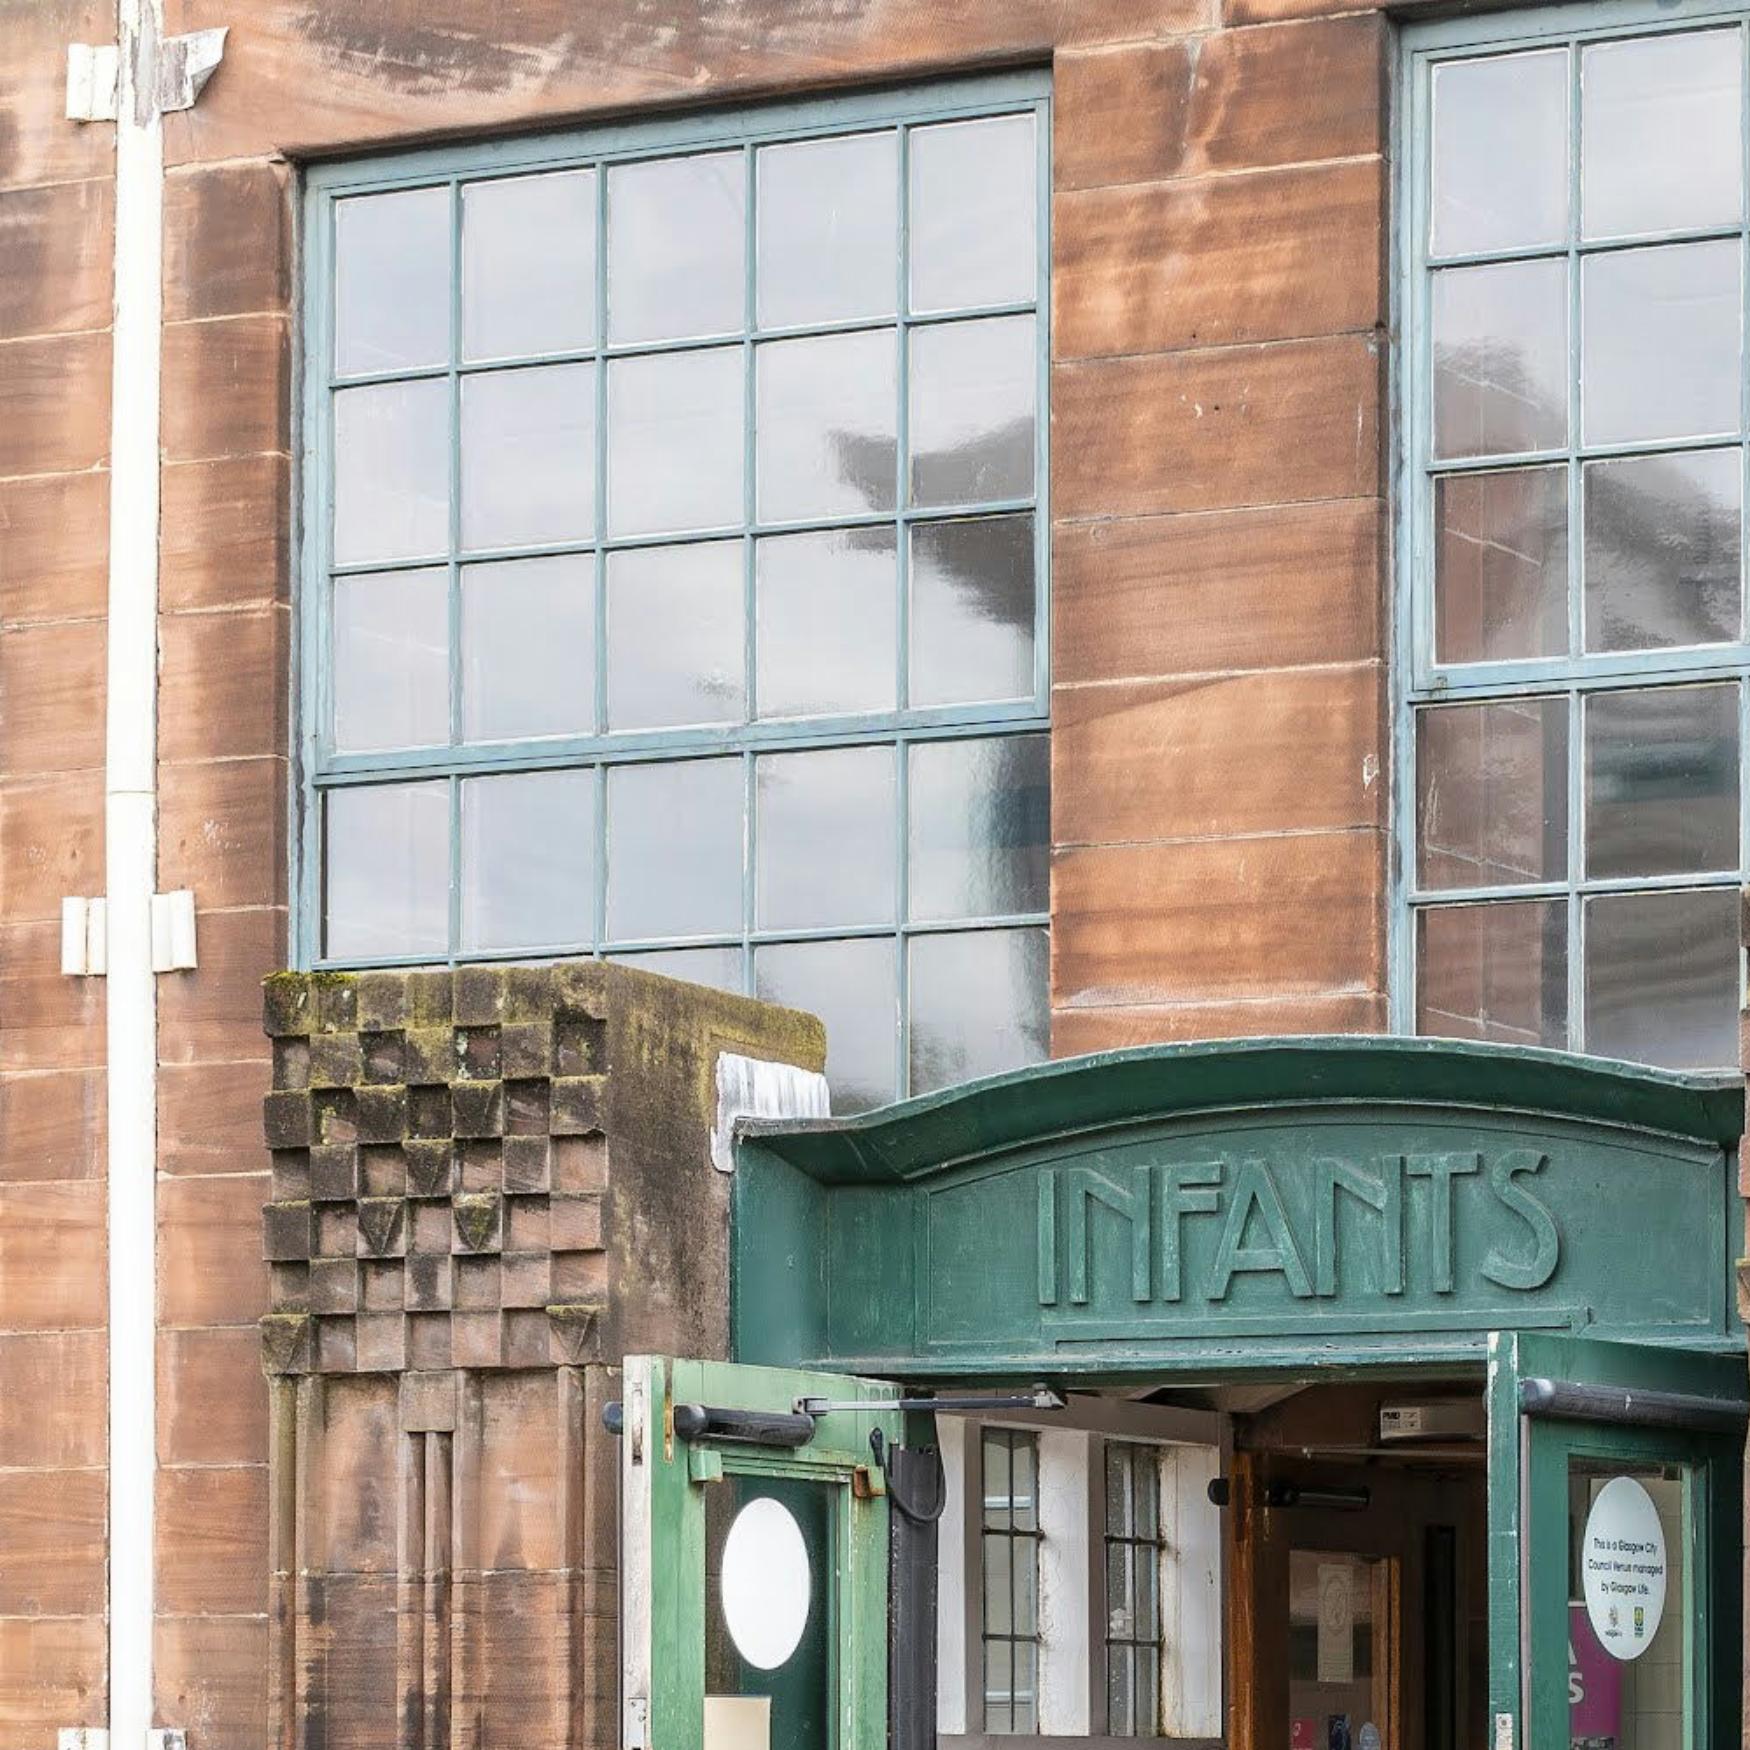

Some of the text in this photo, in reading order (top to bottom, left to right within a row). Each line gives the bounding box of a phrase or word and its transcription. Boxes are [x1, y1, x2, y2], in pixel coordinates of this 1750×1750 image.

[1036, 1149, 1559, 1305] INFANTS
[1593, 1537, 1605, 1549] This
[1611, 1541, 1618, 1551] a
[1618, 1539, 1644, 1555] Glasgow
[1644, 1541, 1658, 1557] City
[1588, 1558, 1613, 1571] Council
[1632, 1562, 1663, 1577] managed
[1600, 1580, 1609, 1595] by
[1610, 1581, 1637, 1595] Glasgow
